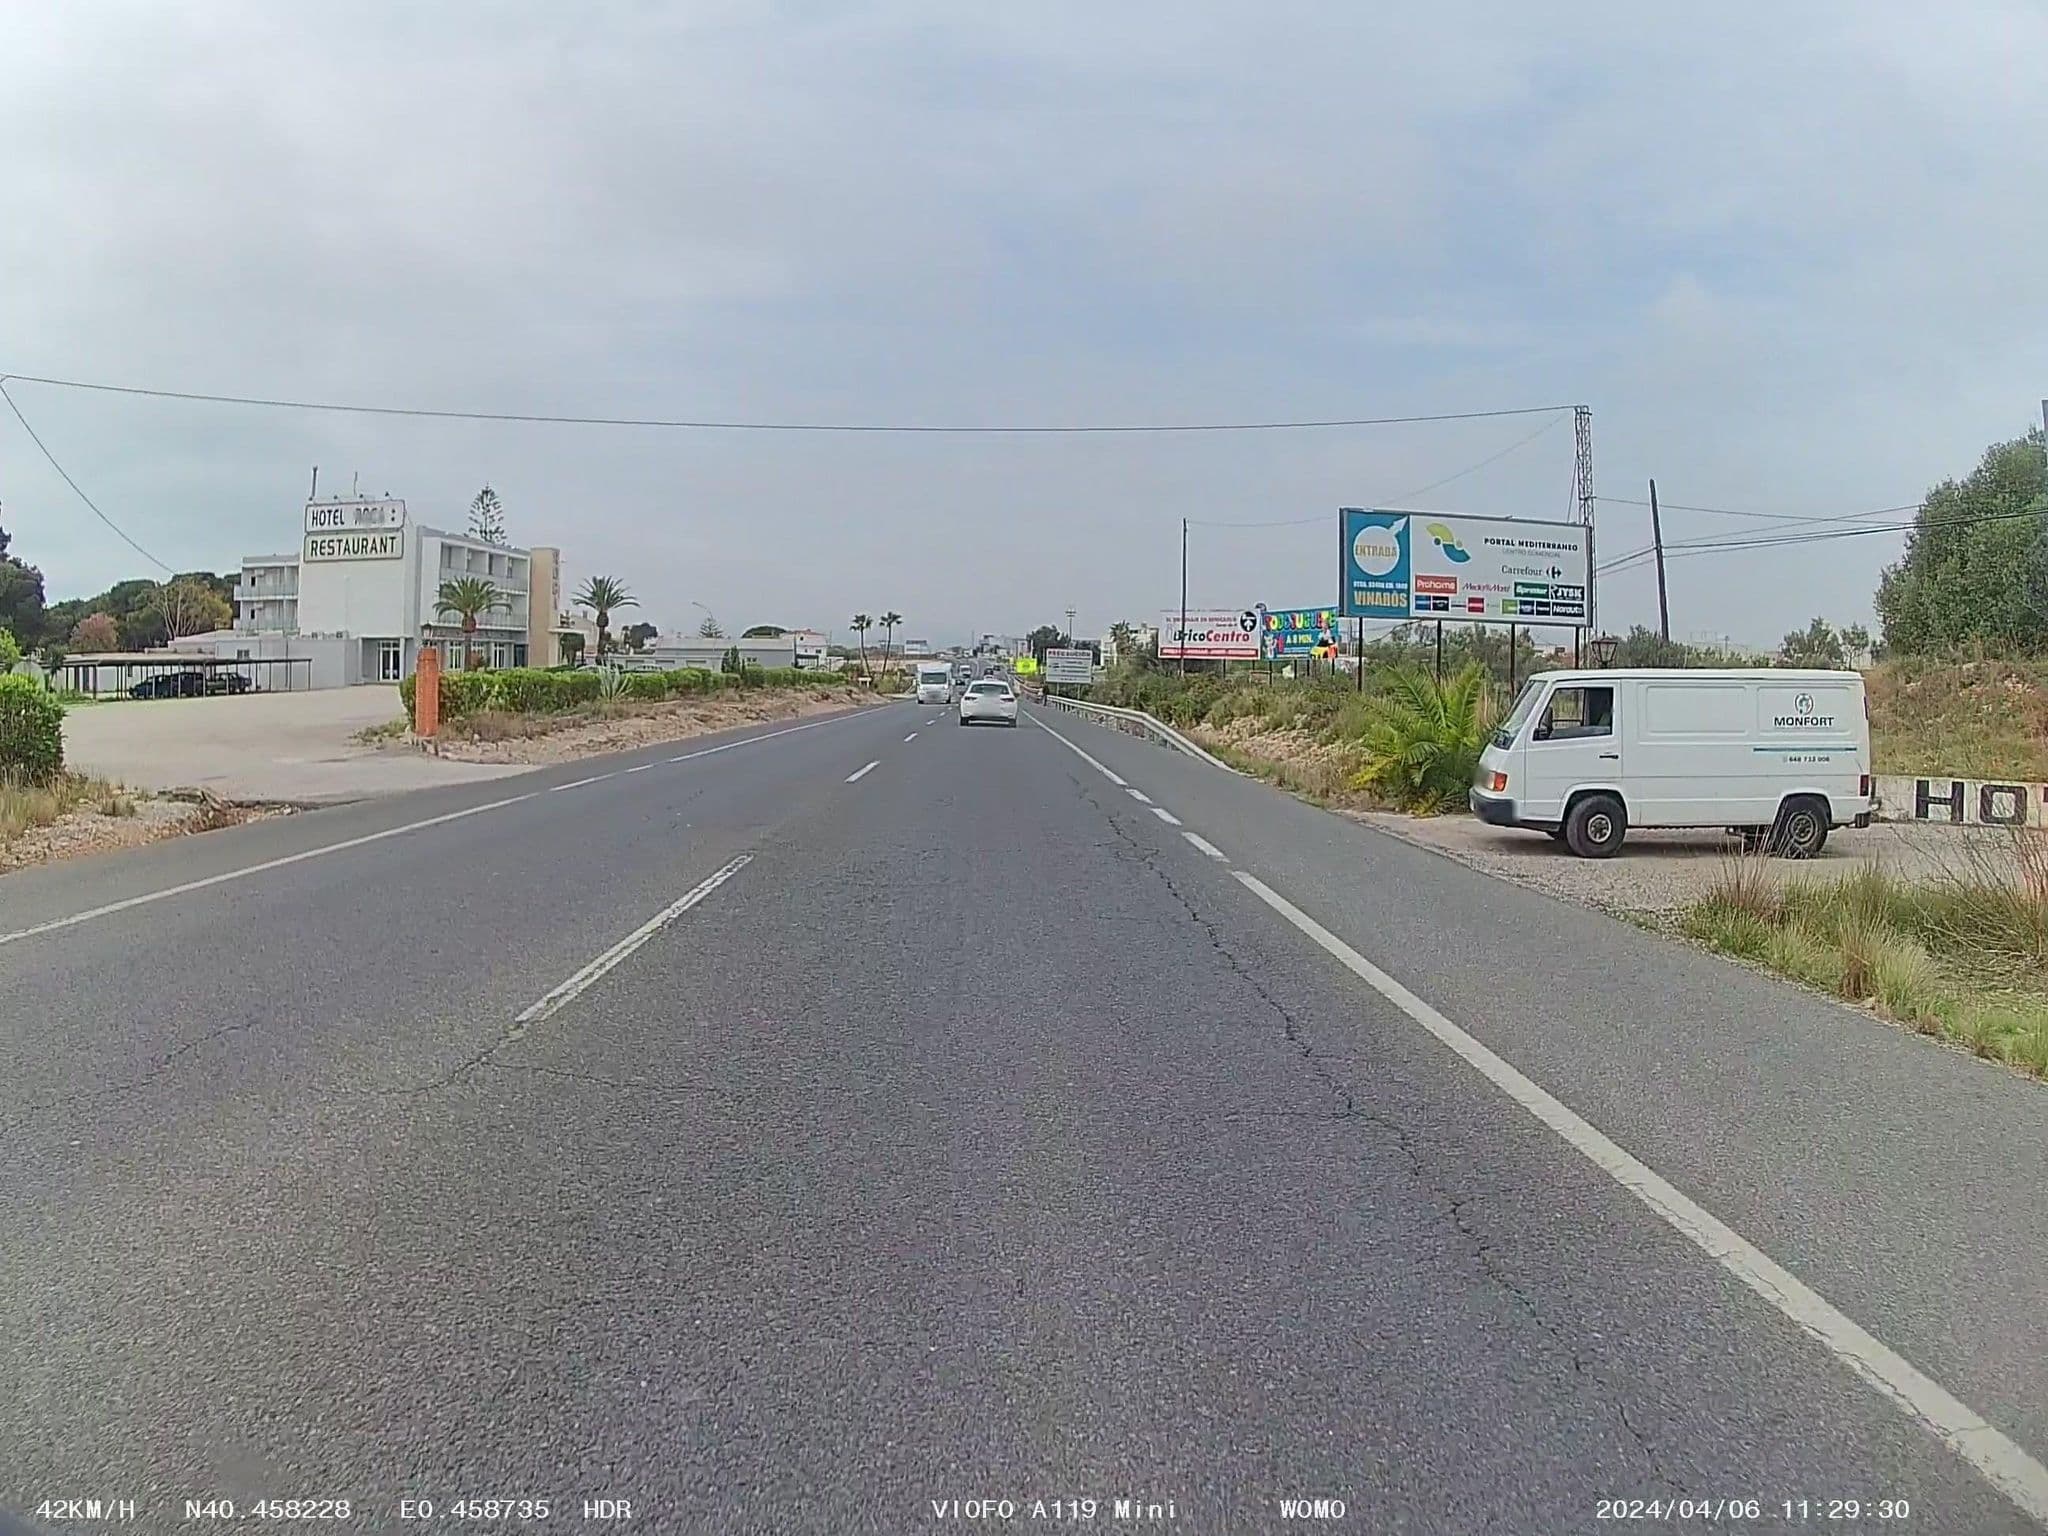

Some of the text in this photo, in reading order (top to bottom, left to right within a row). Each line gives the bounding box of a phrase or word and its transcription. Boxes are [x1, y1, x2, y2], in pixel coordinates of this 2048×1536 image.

[311, 508, 345, 527] HOTEL
[310, 536, 397, 557] RESTAURANT
[1484, 538, 1515, 547] PORTAL
[1355, 544, 1398, 557] ENTRADA
[1501, 565, 1542, 577] Carrefour
[1774, 717, 1835, 726] MONFORT
[1916, 780, 2048, 825] HO
